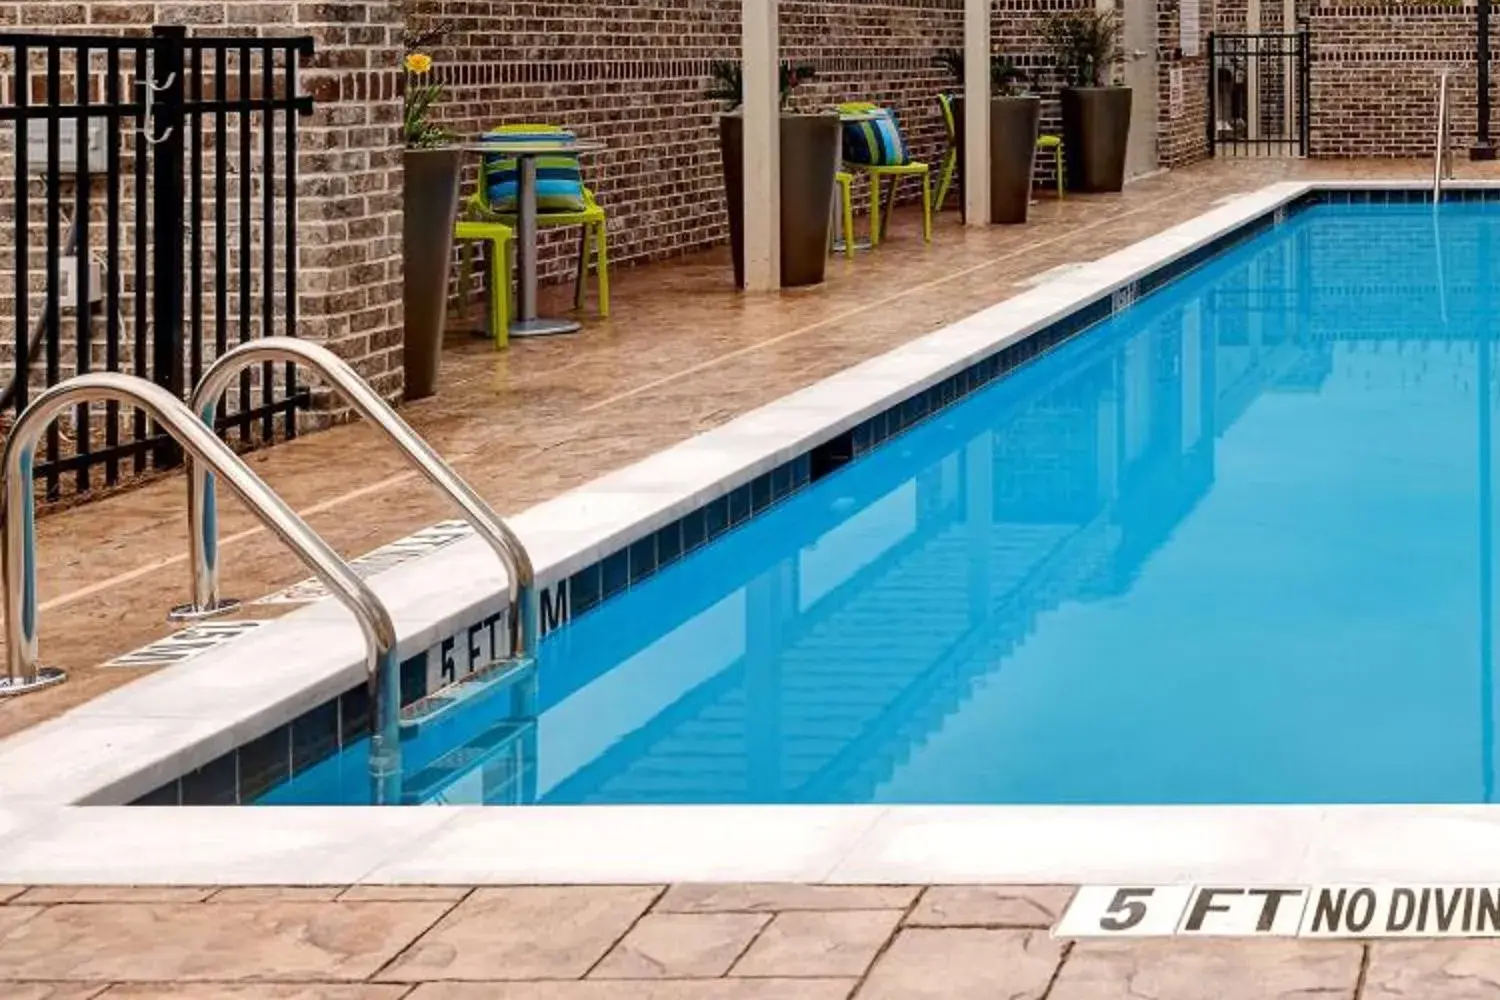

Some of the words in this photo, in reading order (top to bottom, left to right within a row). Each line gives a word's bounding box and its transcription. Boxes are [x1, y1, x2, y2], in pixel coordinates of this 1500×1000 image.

[441, 636, 455, 686] 5
[468, 612, 501, 673] FT
[540, 578, 567, 637] M
[1100, 888, 1155, 931] 5
[1185, 888, 1303, 932] FT
[1311, 887, 1377, 932] NO
